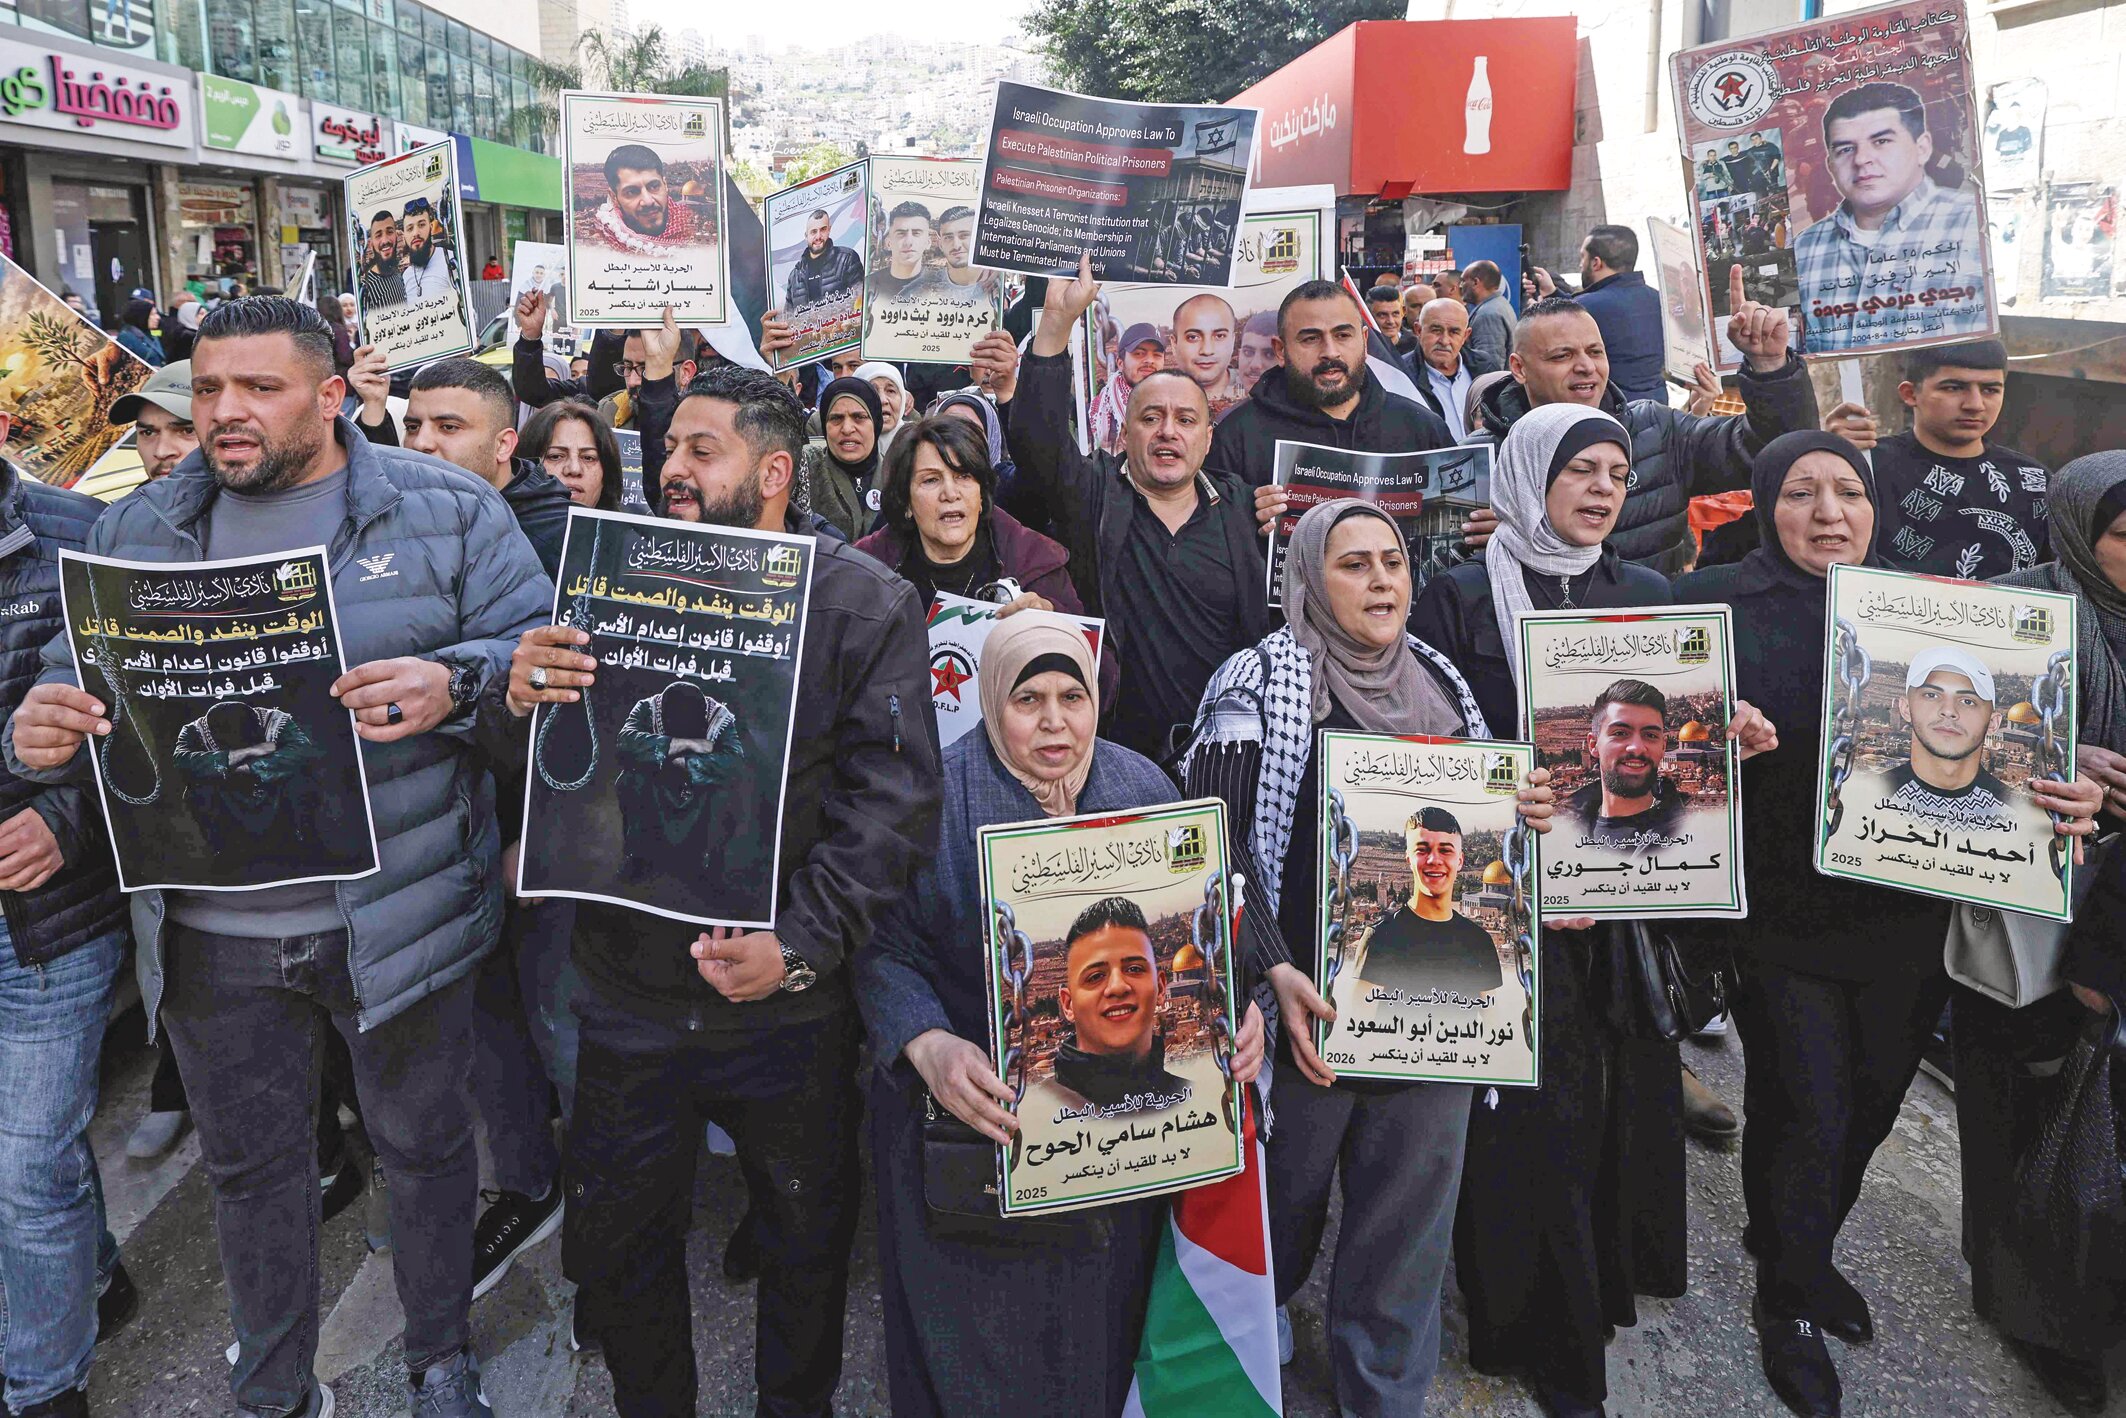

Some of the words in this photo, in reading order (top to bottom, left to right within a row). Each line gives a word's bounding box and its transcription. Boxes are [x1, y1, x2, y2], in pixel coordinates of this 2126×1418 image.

[1872, 19, 1910, 40] المقاومة
[1911, 10, 1958, 33] كتائب
[1761, 37, 1823, 64] الفلسطينية
[1826, 28, 1869, 50] الوطنية
[1817, 50, 1862, 74] العسكري
[1866, 40, 1906, 63] الجناح
[1921, 47, 1960, 68] للجبهة
[1855, 56, 1918, 81] الديمقراطية
[1769, 78, 1811, 100] فلسطين
[1814, 70, 1852, 92] لتحرير
[1012, 106, 1042, 123] Israeli
[1041, 112, 1094, 135] Occupation
[1095, 122, 1142, 141] Approves
[1143, 127, 1164, 140] Law
[1164, 127, 1176, 141] To
[1300, 92, 1336, 138] ماركت
[1002, 136, 1036, 154] Execute
[1036, 143, 1084, 162] Palestinian
[1085, 151, 1121, 167] Political
[1122, 156, 1166, 169] Prisoners
[995, 173, 1035, 190] Palestinian
[1035, 181, 1067, 195] Prisoner
[1067, 185, 1121, 202] Organizations:
[986, 197, 1011, 212] Israeli
[1012, 201, 1044, 217] Knesset
[1044, 207, 1051, 218] A
[1052, 208, 1089, 224] Terrorist
[1089, 214, 1131, 228] Institution
[1131, 217, 1149, 228] that
[984, 214, 1021, 230] Legalizes
[1021, 219, 1062, 237] Genocide;
[1062, 226, 1073, 237] its
[1074, 228, 1124, 244] Membership
[1124, 231, 1132, 242] in
[981, 230, 1034, 248] International
[1035, 238, 1082, 255] Parliaments
[1083, 246, 1099, 257] and
[1099, 246, 1126, 257] Unions
[1922, 241, 1960, 260] الحكم
[979, 245, 999, 258] Must
[1000, 249, 1011, 260] be
[1012, 250, 1058, 268] Terminated
[603, 262, 631, 275] البطل
[663, 263, 693, 274] الحرية
[1861, 286, 1916, 316] عزمي
[1918, 285, 1977, 307] وجدي
[880, 309, 908, 325] داوود
[909, 307, 931, 326] ليث
[936, 311, 964, 327] داوود
[966, 311, 989, 328] كرم
[922, 344, 941, 352] 2025
[1294, 463, 1315, 478] Israeli
[1315, 465, 1352, 484] Occupation
[1353, 472, 1395, 487] Approves
[1396, 474, 1413, 485] Law
[1414, 472, 1423, 484] To
[1287, 489, 1312, 503] Execute
[1380, 500, 1418, 511] Prisoners
[566, 573, 607, 597] قاتل
[9, 600, 39, 616] Rab
[610, 584, 687, 615] والصمت
[691, 592, 734, 620] ينفد
[262, 610, 324, 636] الوقت
[738, 597, 796, 627] الوقت
[78, 614, 120, 636] قاتل
[125, 622, 204, 646] والصمت
[210, 620, 257, 643] ينفد
[636, 619, 686, 648] إعدام
[275, 637, 328, 662] أوقفوا
[688, 628, 734, 651] قانون
[738, 630, 791, 657] أوقفوا
[162, 653, 212, 676] إعدام
[217, 646, 267, 672] قانون
[604, 646, 649, 670] الأوان
[653, 654, 697, 678] فوات
[700, 659, 732, 683] قبل
[139, 677, 182, 700] الأوان
[187, 679, 235, 700] فوات
[241, 672, 275, 696] قبل
[1874, 797, 1916, 817] البطل
[1854, 814, 1948, 849] الخراز
[1971, 814, 2018, 833] الحرية
[1575, 834, 1610, 850] البطل
[1612, 830, 1652, 850] للأسير
[1653, 833, 1693, 849] الحرية
[1831, 853, 1862, 868] 2025
[1956, 838, 2035, 866] أحمد
[1546, 857, 1634, 879] جوري
[1639, 852, 1721, 876] كمال
[1543, 895, 1570, 906] 2025
[1364, 988, 1404, 1006] البطل
[1404, 986, 1448, 1009] للأسير
[1452, 990, 1495, 1009] الحرية
[1346, 1015, 1404, 1039] السعود
[1407, 1014, 1434, 1042] أبو
[1436, 1020, 1484, 1044] الدين
[1485, 1020, 1514, 1047] نور
[1327, 1051, 1356, 1065] 2026
[1368, 1047, 1409, 1066] ينكسر
[1410, 1048, 1424, 1065] أن
[1427, 1050, 1458, 1067] للقيد
[1461, 1053, 1478, 1068] بد
[1479, 1052, 1490, 1065] لا
[1096, 1093, 1143, 1122] للأسير
[1146, 1087, 1193, 1110] الحرية
[1053, 1102, 1095, 1126] البطل
[1161, 1110, 1219, 1144] هشام
[1026, 1133, 1092, 1167] الحوح
[1097, 1126, 1157, 1158] سامي
[1106, 1156, 1121, 1175] أن
[1125, 1153, 1158, 1175] للقيد
[1161, 1151, 1176, 1167] بد
[1180, 1146, 1191, 1162] لا
[1060, 1162, 1104, 1185] ينكسر
[1016, 1186, 1048, 1201] 2025
